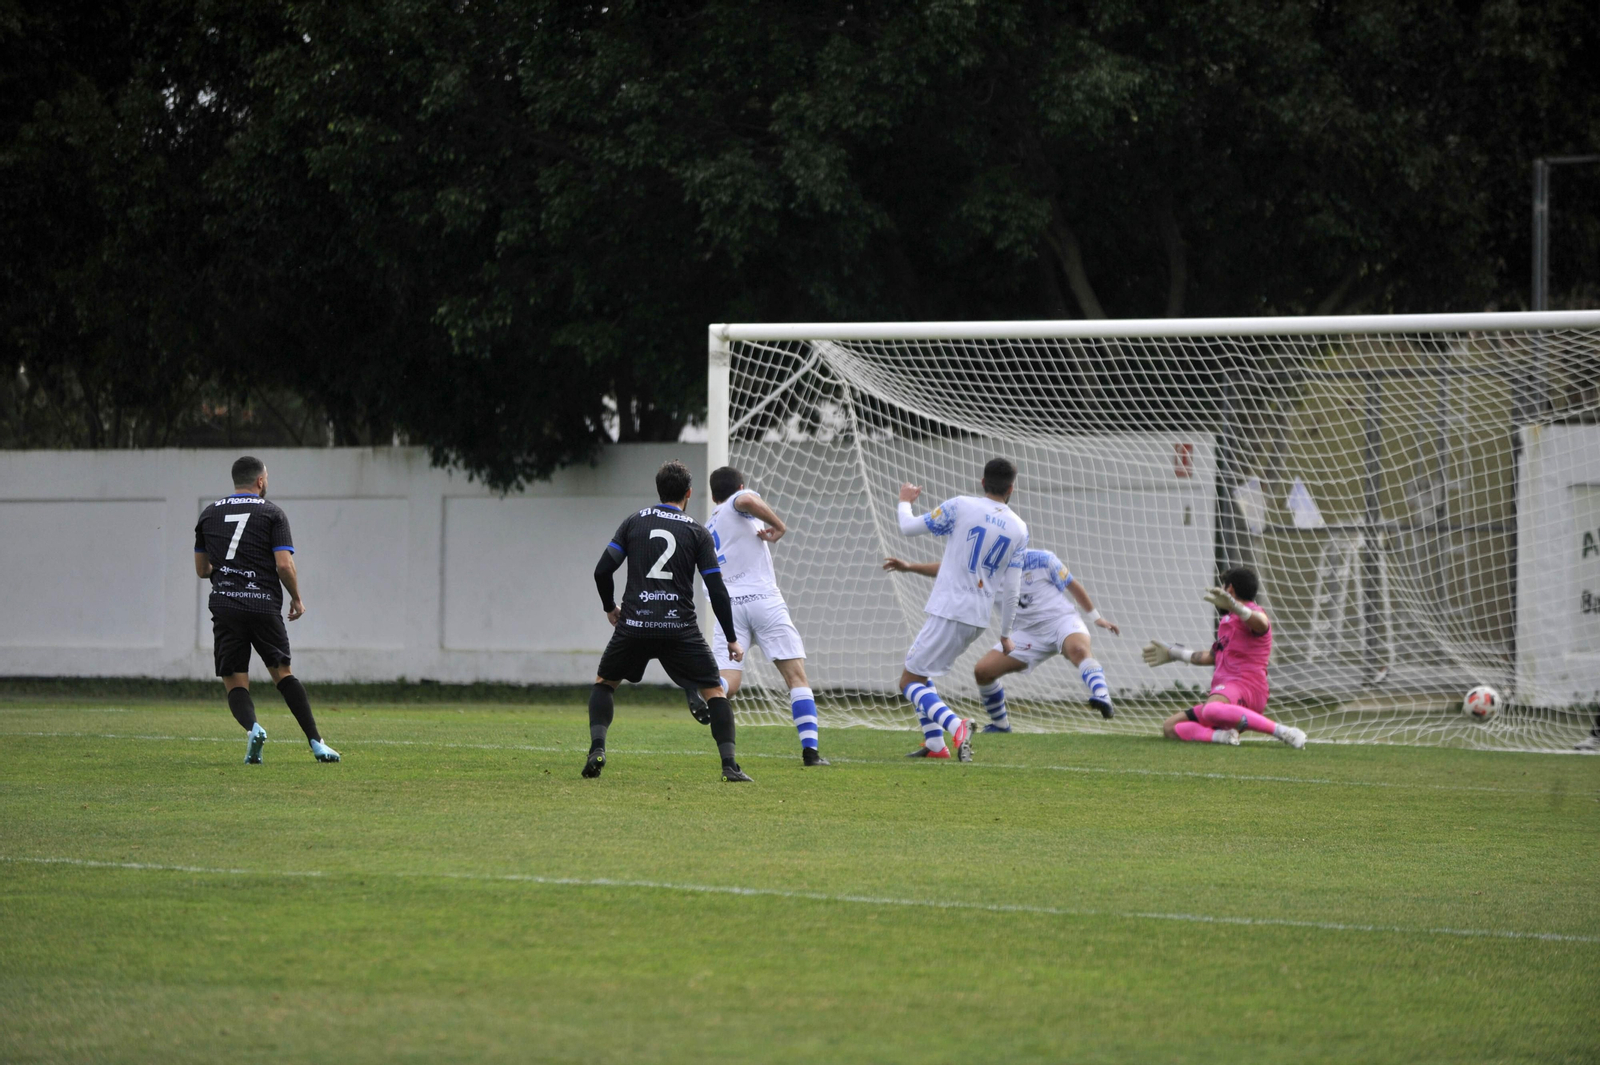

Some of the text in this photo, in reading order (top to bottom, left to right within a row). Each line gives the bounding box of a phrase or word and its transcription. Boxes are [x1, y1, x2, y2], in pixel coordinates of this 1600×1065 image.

[224, 512, 251, 560] 7
[985, 514, 1007, 531] RAUL
[646, 529, 677, 580] 2
[966, 525, 1012, 579] 14
[226, 591, 262, 599] DEPORTIVO
